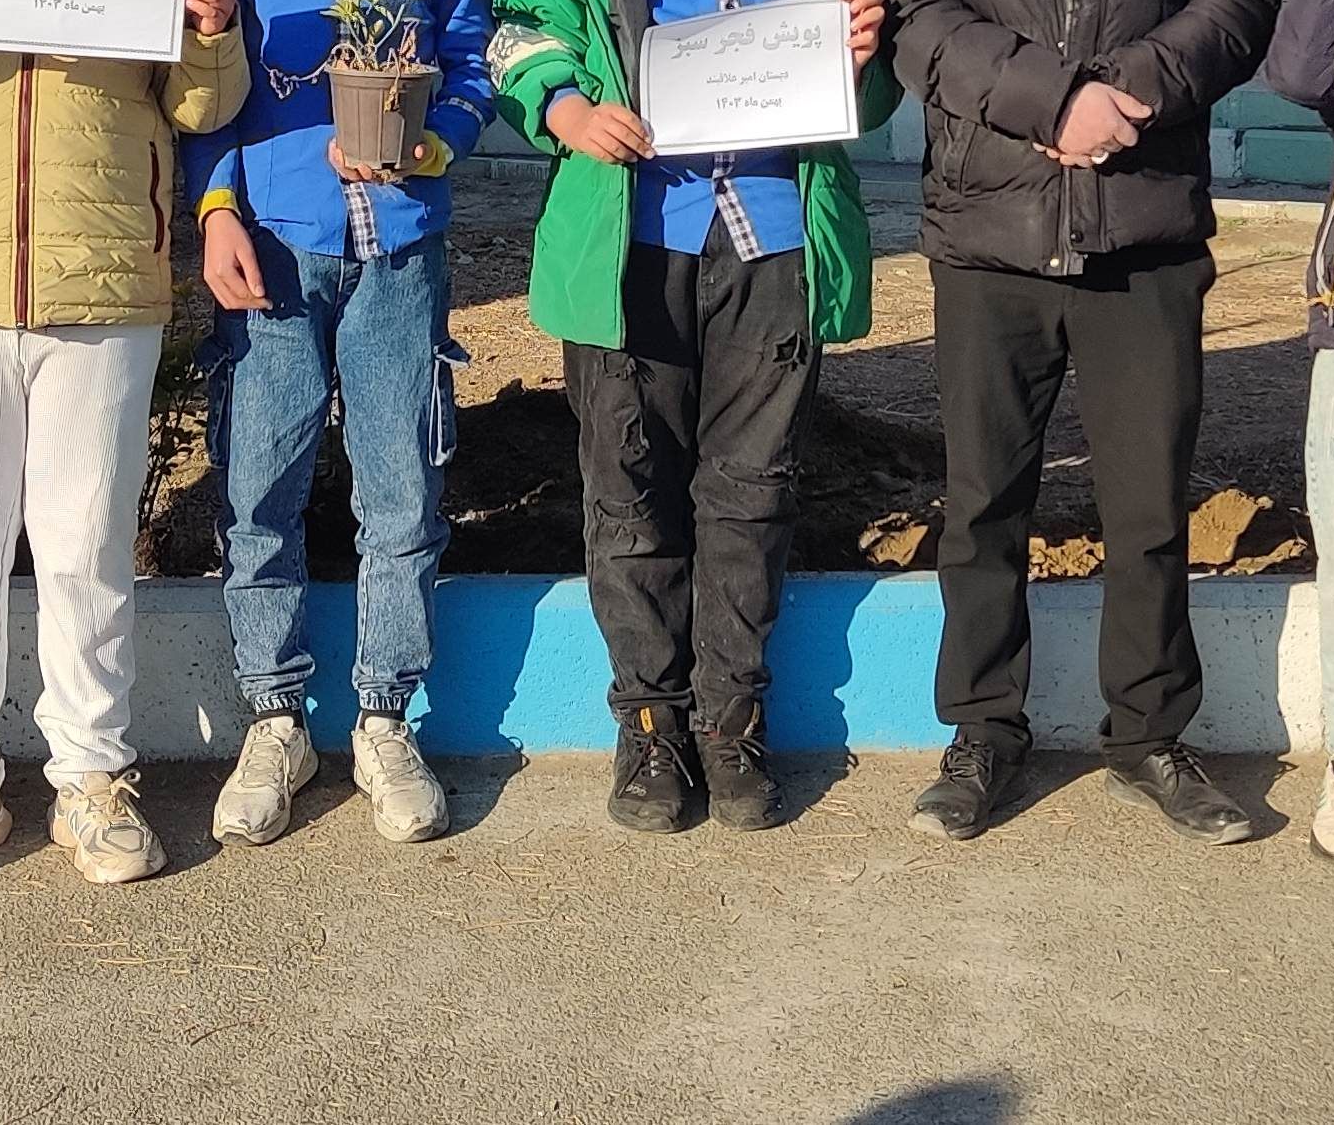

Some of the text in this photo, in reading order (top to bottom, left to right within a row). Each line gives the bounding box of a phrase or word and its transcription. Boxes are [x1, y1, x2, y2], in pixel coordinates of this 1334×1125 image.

[63, 0, 80, 11] ماه
[81, 2, 106, 16] بهمن
[670, 20, 823, 59] پویش فجر سبز
[744, 96, 758, 107] ماه
